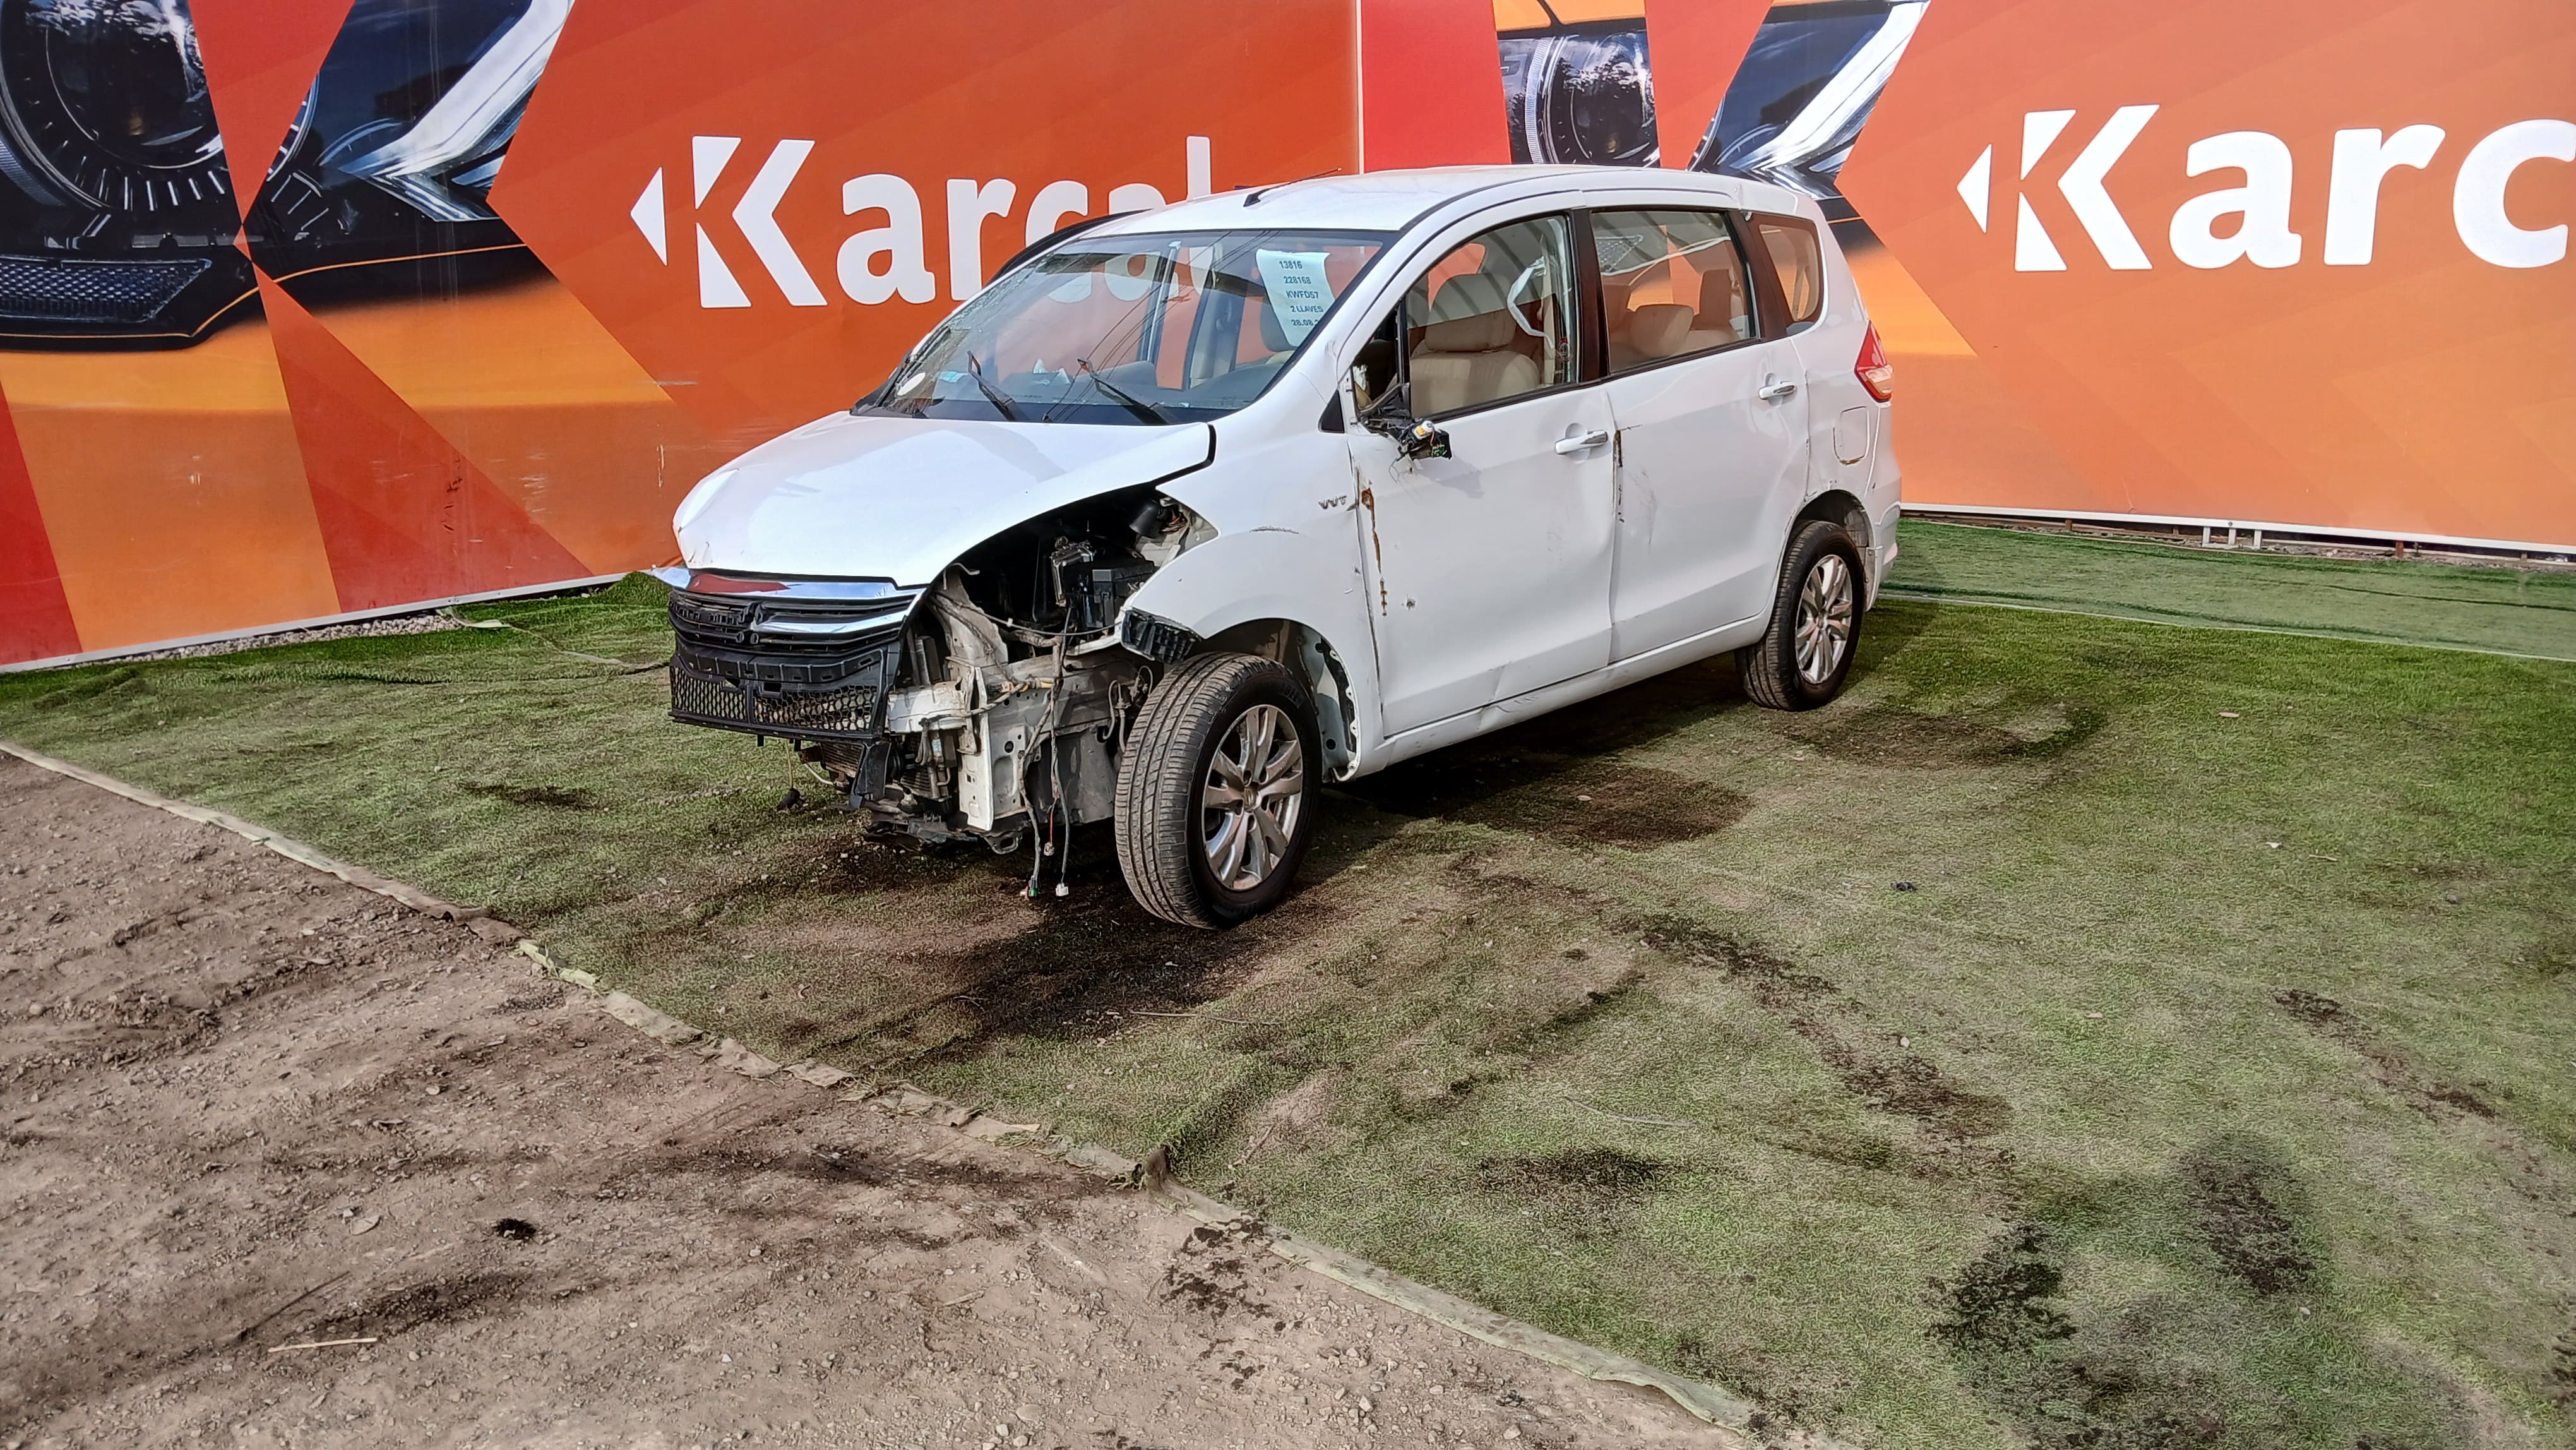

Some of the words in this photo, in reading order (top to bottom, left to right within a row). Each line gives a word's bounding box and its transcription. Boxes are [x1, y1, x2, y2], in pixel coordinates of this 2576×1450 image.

[1957, 104, 2576, 272] Karc
[1279, 260, 1303, 269] 13816
[1284, 276, 1311, 284] 228168
[1286, 291, 1318, 299] KWFD57
[1318, 495, 1347, 510] VVT
